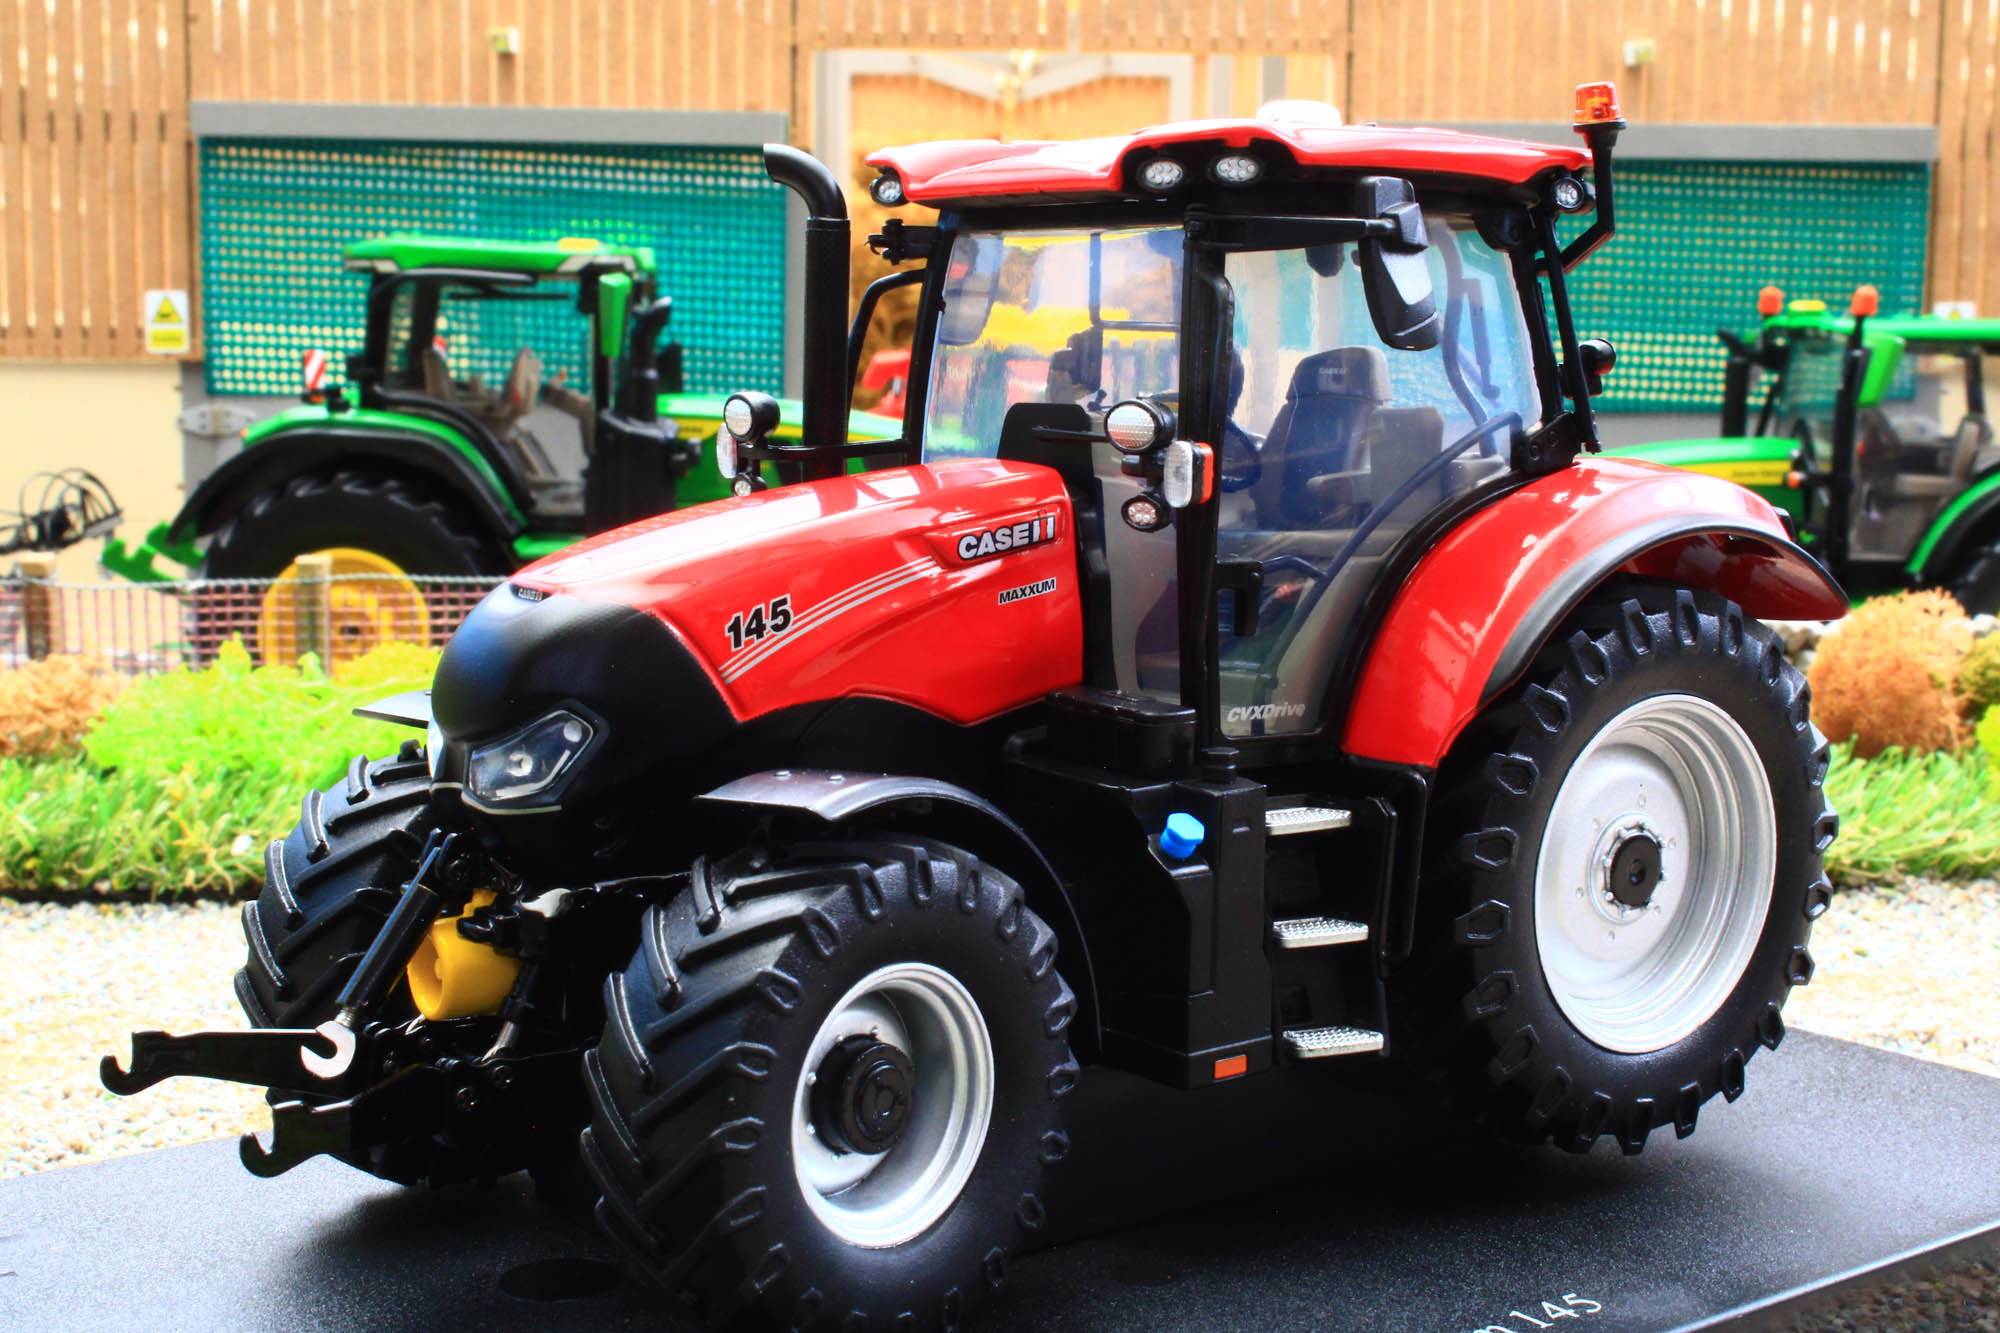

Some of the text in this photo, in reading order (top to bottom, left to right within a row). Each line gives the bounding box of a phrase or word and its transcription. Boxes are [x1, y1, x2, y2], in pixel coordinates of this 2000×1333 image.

[958, 521, 1031, 559] CASE
[998, 578, 1056, 604] MAXXUM
[726, 595, 792, 649] 145
[1226, 701, 1306, 723] CVXDrive
[1509, 1293, 1602, 1329] 145
